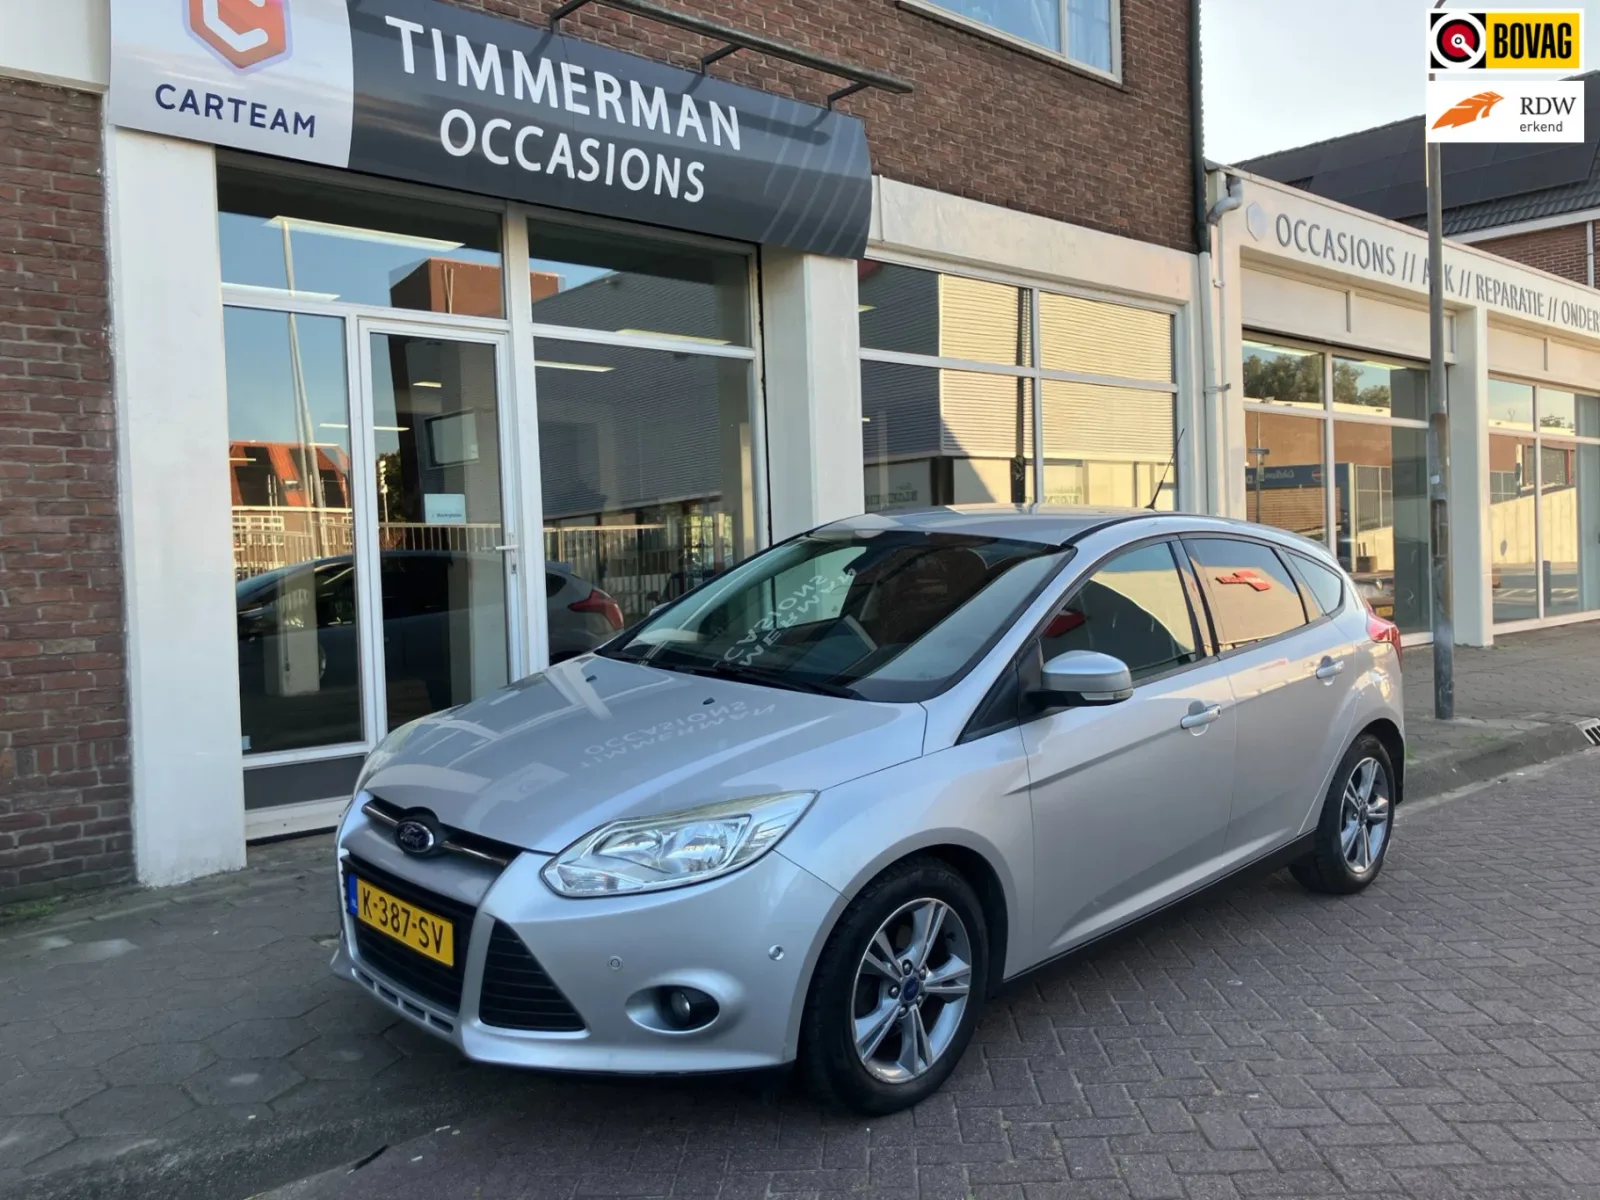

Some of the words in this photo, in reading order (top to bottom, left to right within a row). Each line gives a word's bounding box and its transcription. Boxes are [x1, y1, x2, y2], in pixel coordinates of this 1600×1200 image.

[154, 83, 316, 139] CARTEAM
[385, 15, 741, 151] TIMMERMAN
[440, 109, 705, 203] OCCASIONS
[1275, 213, 1396, 277] OCCASIONS
[1422, 257, 1455, 293] AK
[1475, 273, 1545, 318] REPARATIE
[400, 825, 423, 847] Ford
[362, 887, 444, 954] K-387-SV
